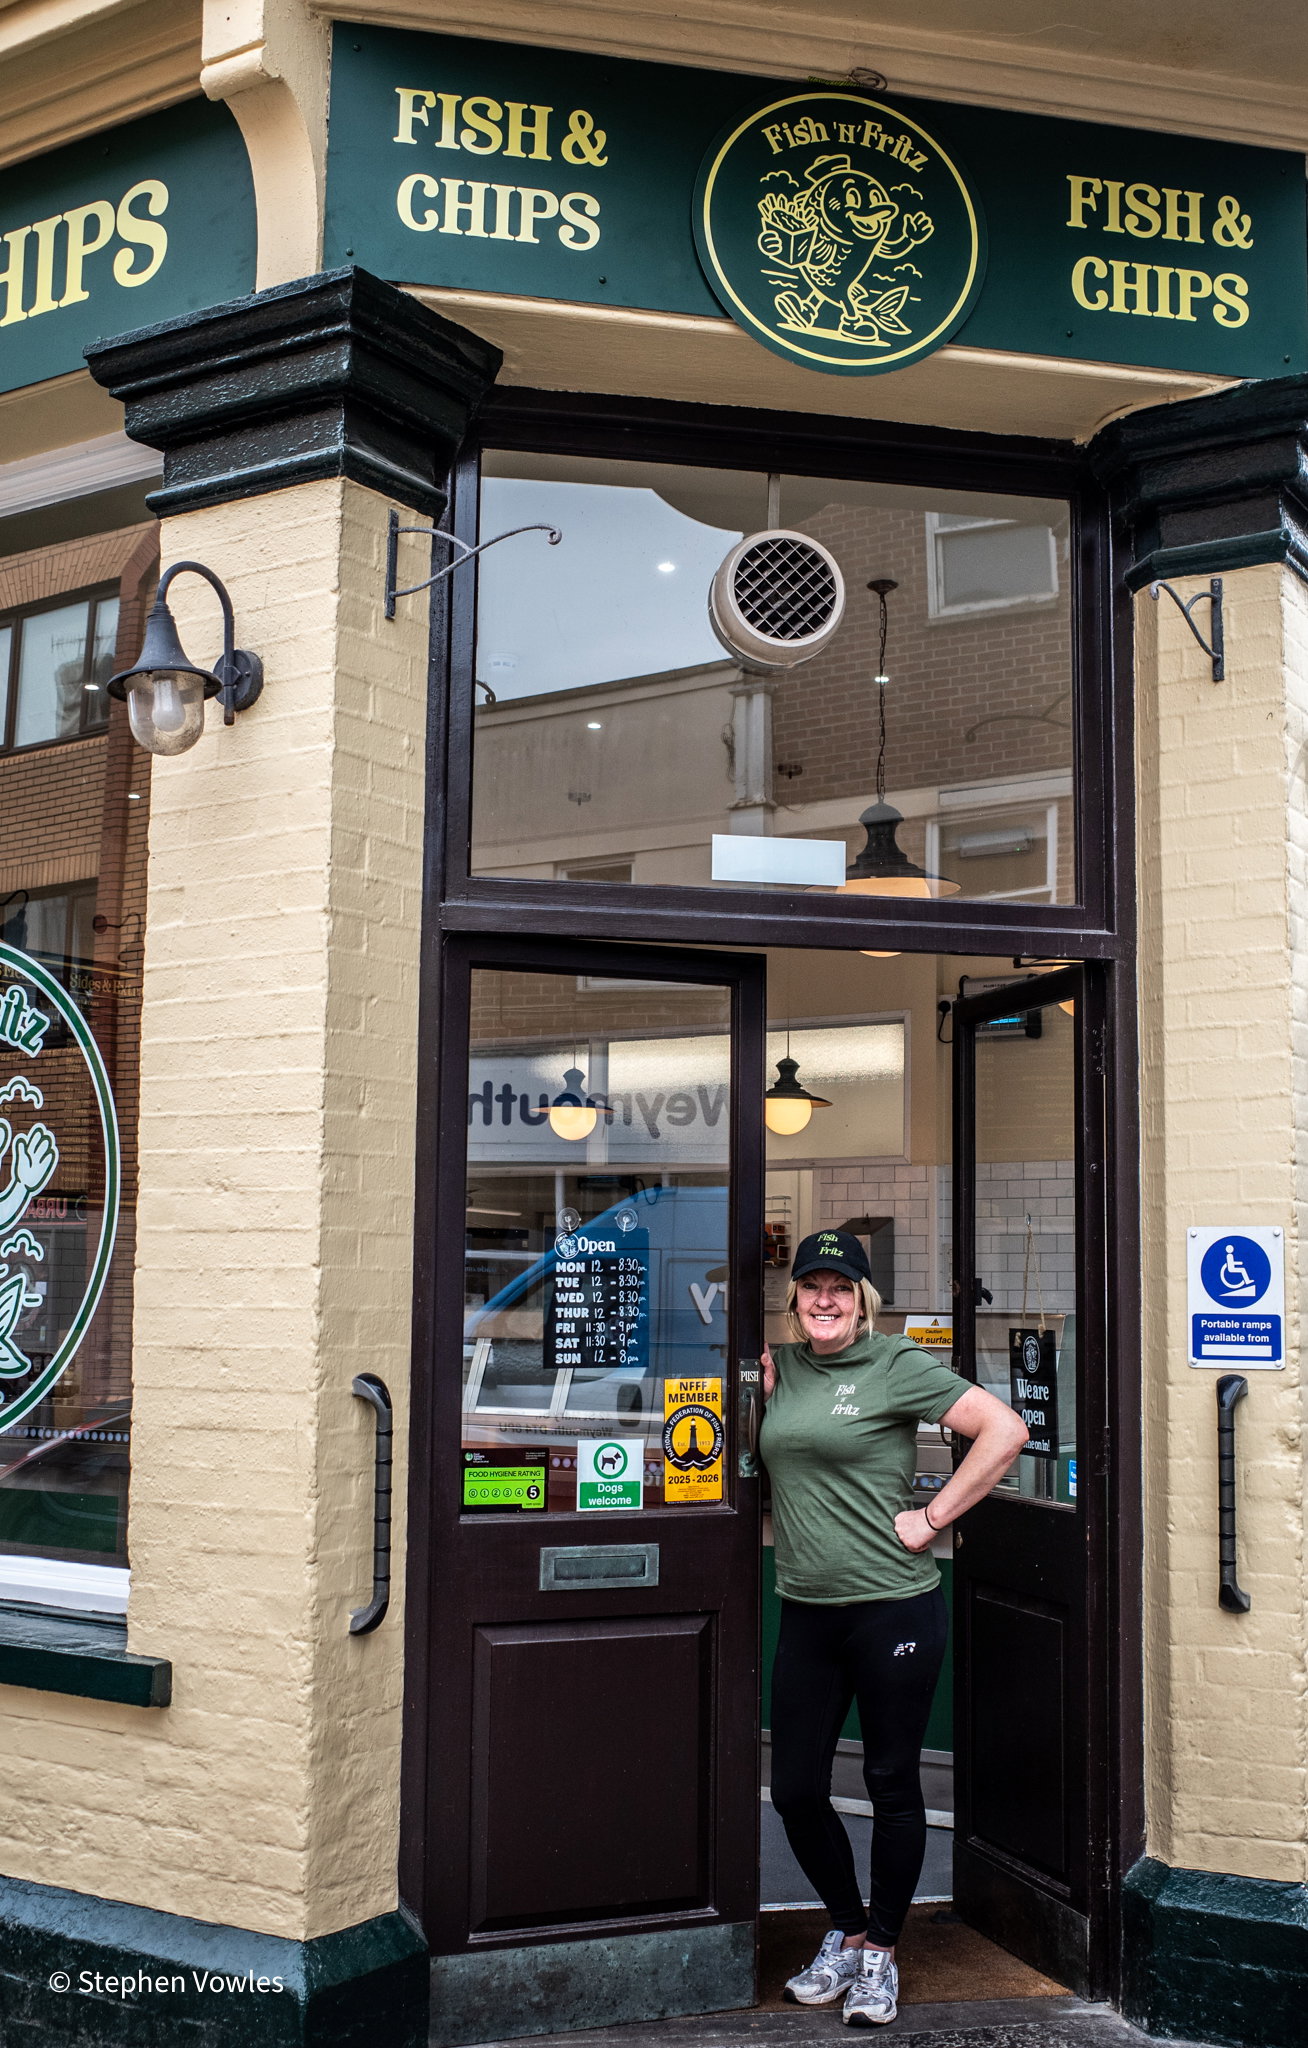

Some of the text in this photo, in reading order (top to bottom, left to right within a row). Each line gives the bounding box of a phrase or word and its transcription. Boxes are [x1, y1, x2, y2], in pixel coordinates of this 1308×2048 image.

[393, 87, 609, 168] FISH &
[761, 117, 830, 155] Fish
[860, 120, 929, 173] Fritz
[396, 173, 602, 252] CHIPS
[1066, 173, 1254, 250] FISH &
[0, 179, 170, 328] HIPS
[1071, 256, 1251, 330] CHIPS
[69, 974, 101, 992] Sides
[102, 979, 112, 993] &
[0, 986, 49, 1056] itz
[817, 1233, 839, 1242] Fish
[577, 1236, 617, 1255] Open
[819, 1246, 844, 1257] Fritz
[555, 1262, 586, 1273] MON
[591, 1260, 604, 1273] 12
[555, 1277, 580, 1288] TUE
[591, 1276, 603, 1287] 12
[555, 1292, 585, 1303] WED
[593, 1291, 604, 1303] 12
[555, 1307, 589, 1318] THUR
[594, 1308, 606, 1319] 12
[555, 1322, 576, 1333] FRI
[585, 1322, 606, 1332] 11:30
[1200, 1319, 1272, 1331] Portable ramps
[555, 1338, 580, 1349] SAT
[585, 1336, 606, 1347] 11:30
[925, 1336, 953, 1344] surfac
[1204, 1333, 1270, 1343] available from
[555, 1353, 582, 1364] SUN
[594, 1350, 606, 1363] 12
[740, 1371, 759, 1382] PUSH
[679, 1381, 708, 1391] NFFF
[834, 1384, 856, 1396] Fish
[1016, 1378, 1050, 1401] We are
[668, 1392, 719, 1403] MEMBER
[831, 1404, 860, 1416] Fritz
[1021, 1408, 1046, 1428] open
[664, 1407, 722, 1458] NATIONAL FEDERATION OF FISH FRIERS
[1035, 1440, 1042, 1450] on
[468, 1470, 489, 1478] FOOD
[668, 1475, 691, 1485] 2025
[696, 1474, 719, 1484] 2026
[529, 1486, 538, 1499] 5
[597, 1484, 624, 1495] Dogs
[588, 1496, 632, 1506] welcome
